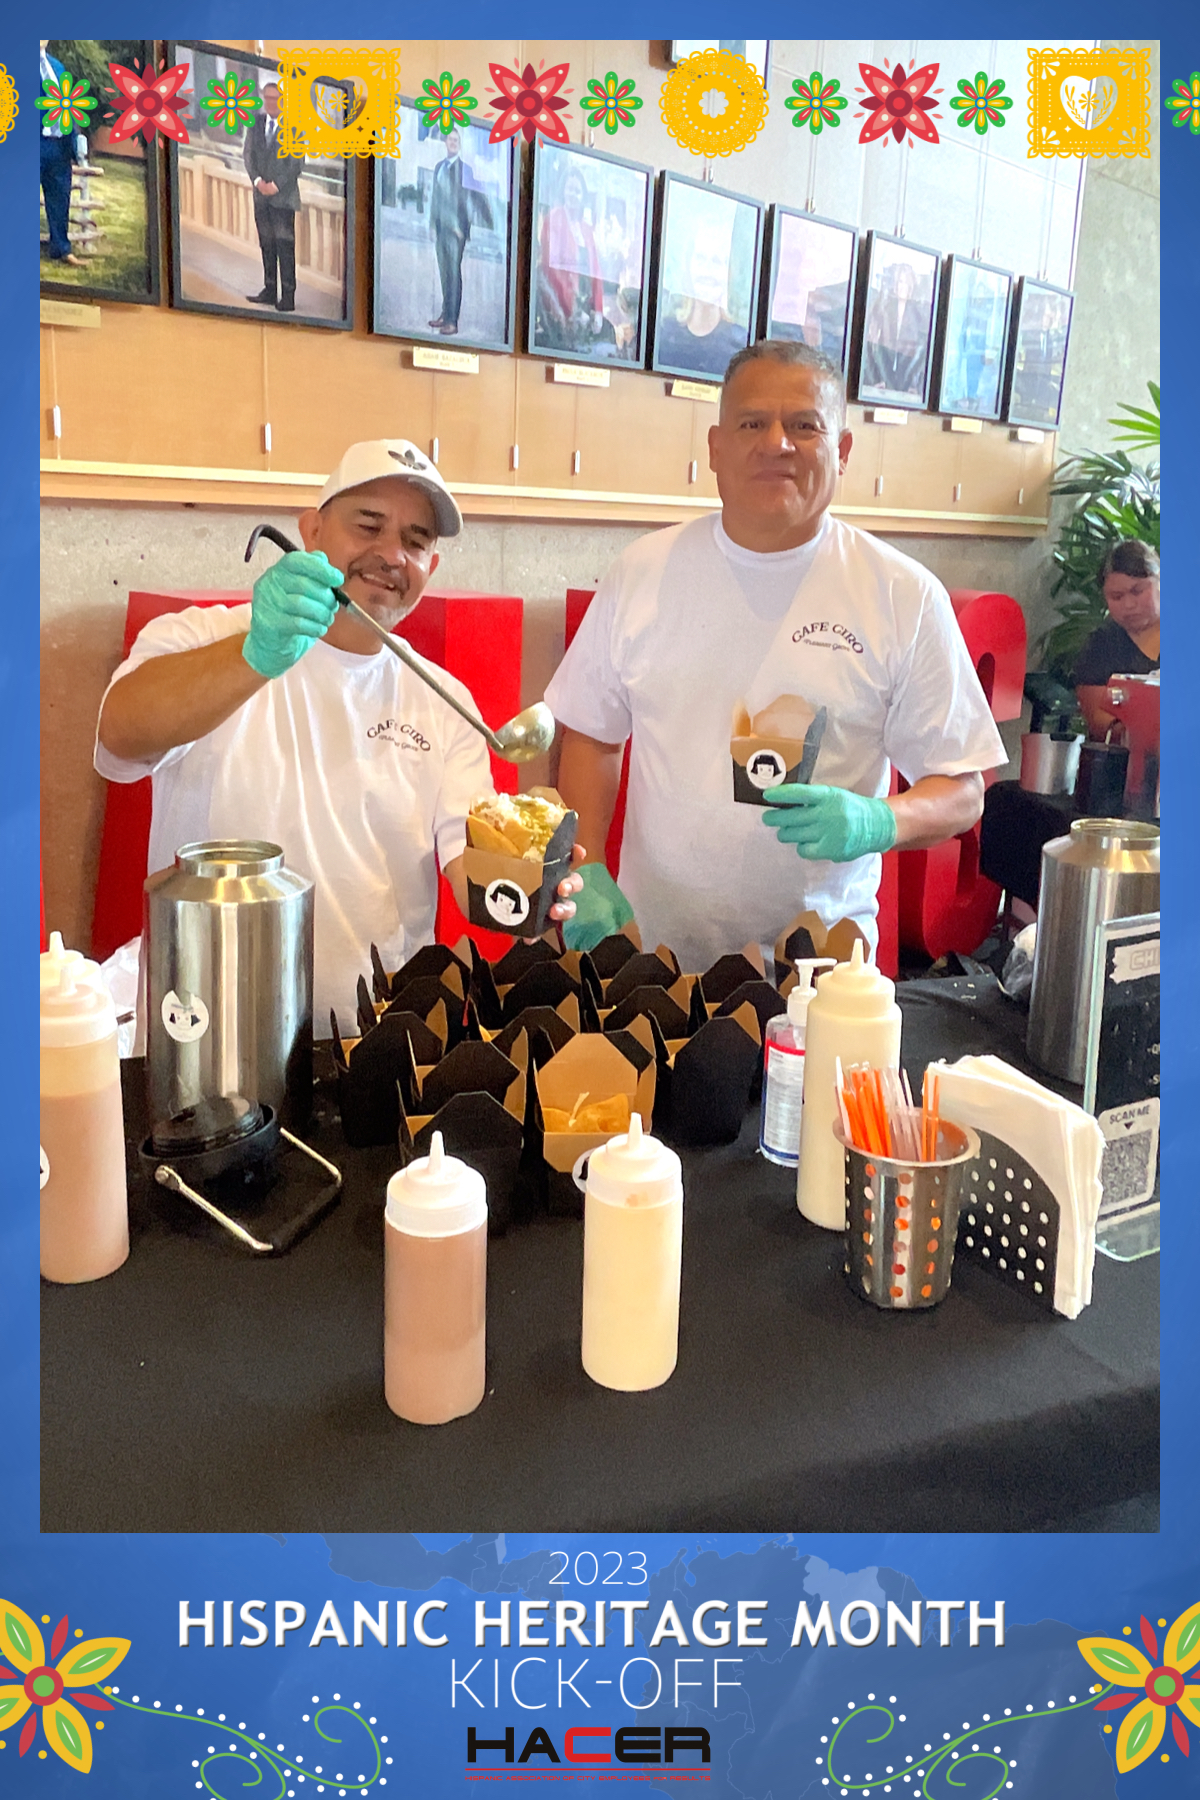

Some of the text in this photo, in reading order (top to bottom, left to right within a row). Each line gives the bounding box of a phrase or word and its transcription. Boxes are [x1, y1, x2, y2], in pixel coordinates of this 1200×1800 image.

[792, 622, 829, 643] CAFE
[1110, 1105, 1150, 1124] SCAN ME
